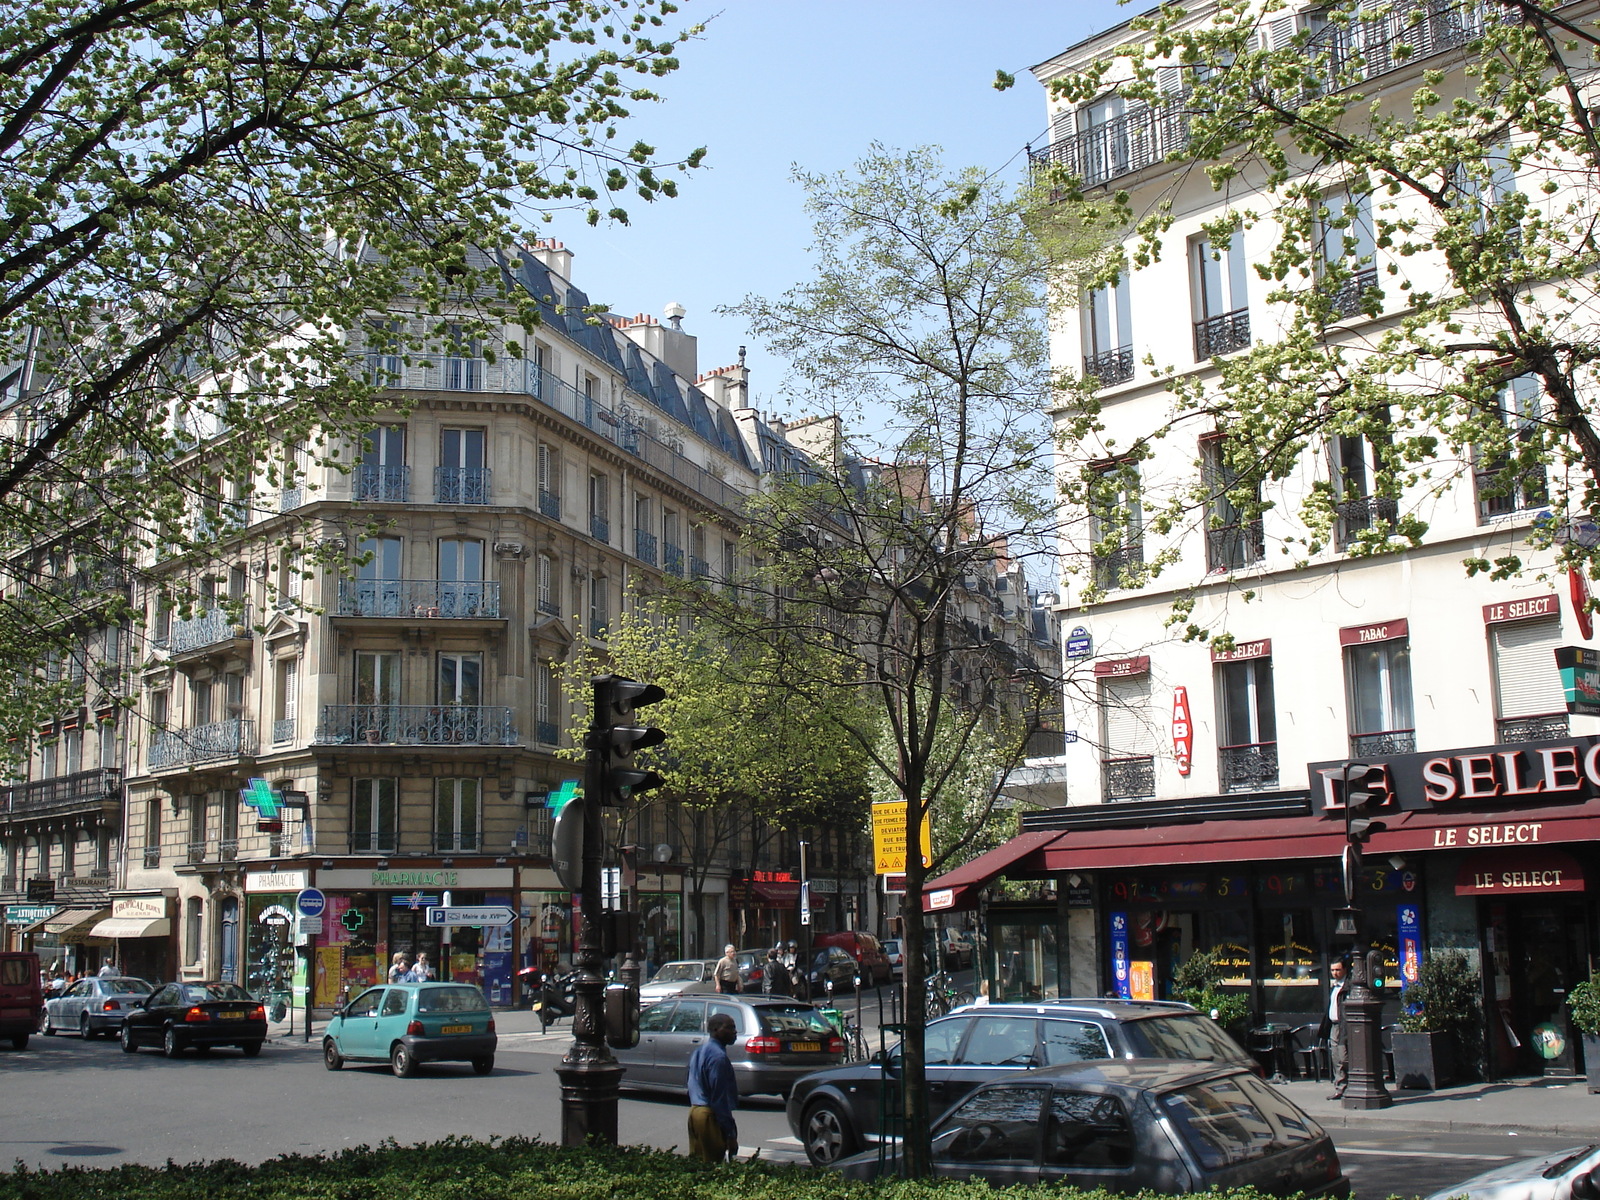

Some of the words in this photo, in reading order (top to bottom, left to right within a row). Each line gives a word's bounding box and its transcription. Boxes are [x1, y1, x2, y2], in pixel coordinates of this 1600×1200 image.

[1491, 606, 1504, 620] LE
[1509, 599, 1550, 618] SELECT
[1359, 626, 1388, 642] TABAC
[1231, 642, 1264, 659] SELECT
[1173, 689, 1189, 772] TABAC
[1434, 829, 1457, 847] LE
[1467, 824, 1542, 845] SELECT
[259, 873, 295, 887] PHARMACIE
[371, 872, 458, 886] PHARMACIE
[1475, 873, 1494, 888] LE
[1502, 870, 1562, 888] SELECT
[114, 899, 144, 914] TROPICAL
[1407, 941, 1415, 980] RAPIDO
